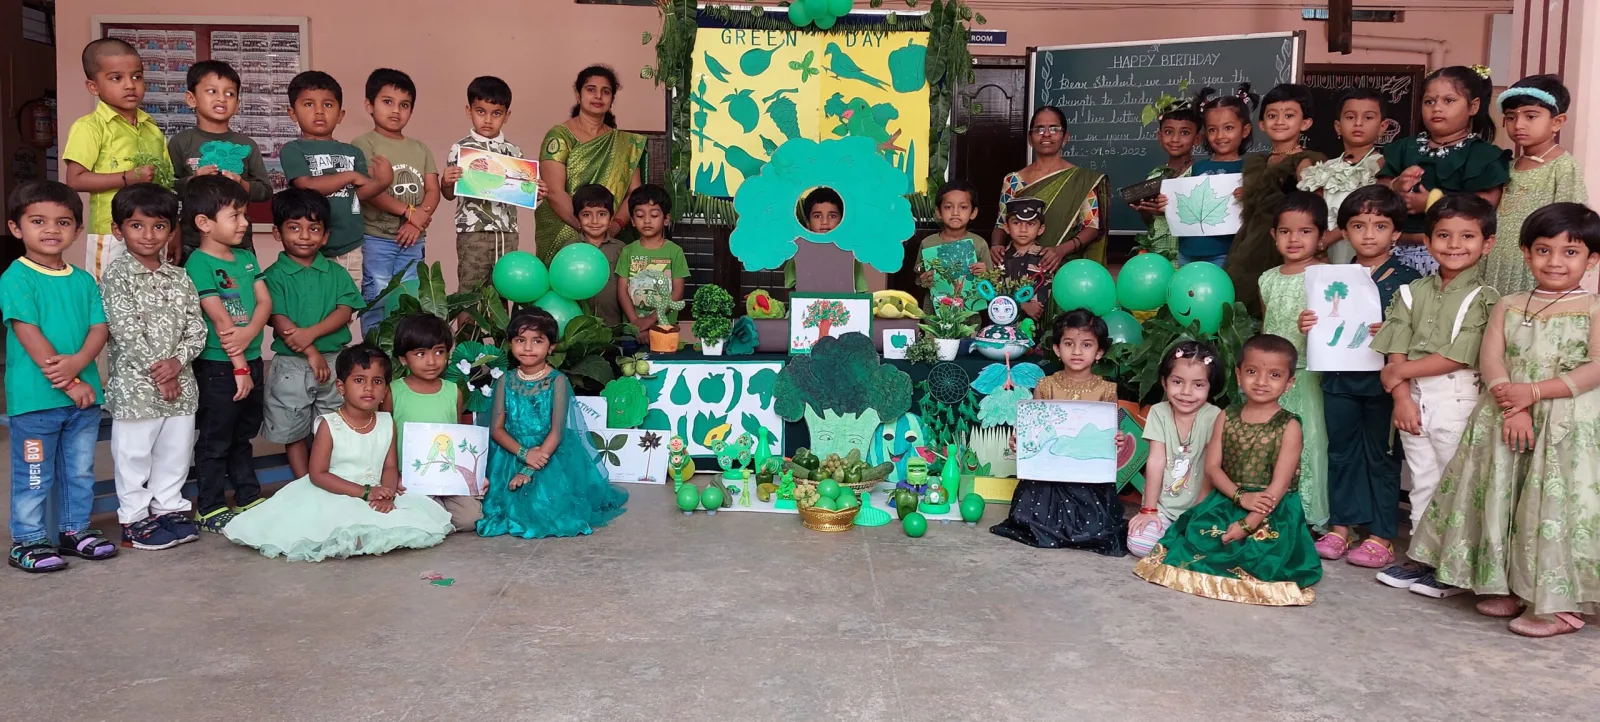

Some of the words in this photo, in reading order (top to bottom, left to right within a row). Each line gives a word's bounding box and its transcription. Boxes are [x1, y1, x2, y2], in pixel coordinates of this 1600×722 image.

[721, 29, 797, 47] GREEN
[846, 31, 884, 48] DAY
[1113, 54, 1156, 68] HAPPY
[1161, 53, 1221, 67] BIRTHDAY
[1059, 73, 1088, 90] Dear
[1202, 76, 1225, 88] you
[1231, 69, 1252, 83] the
[1055, 92, 1096, 116] strength
[1101, 92, 1113, 106] to
[575, 401, 601, 420] CTIVITY
[26, 440, 40, 460] BOY
[29, 463, 41, 490] SUPER
